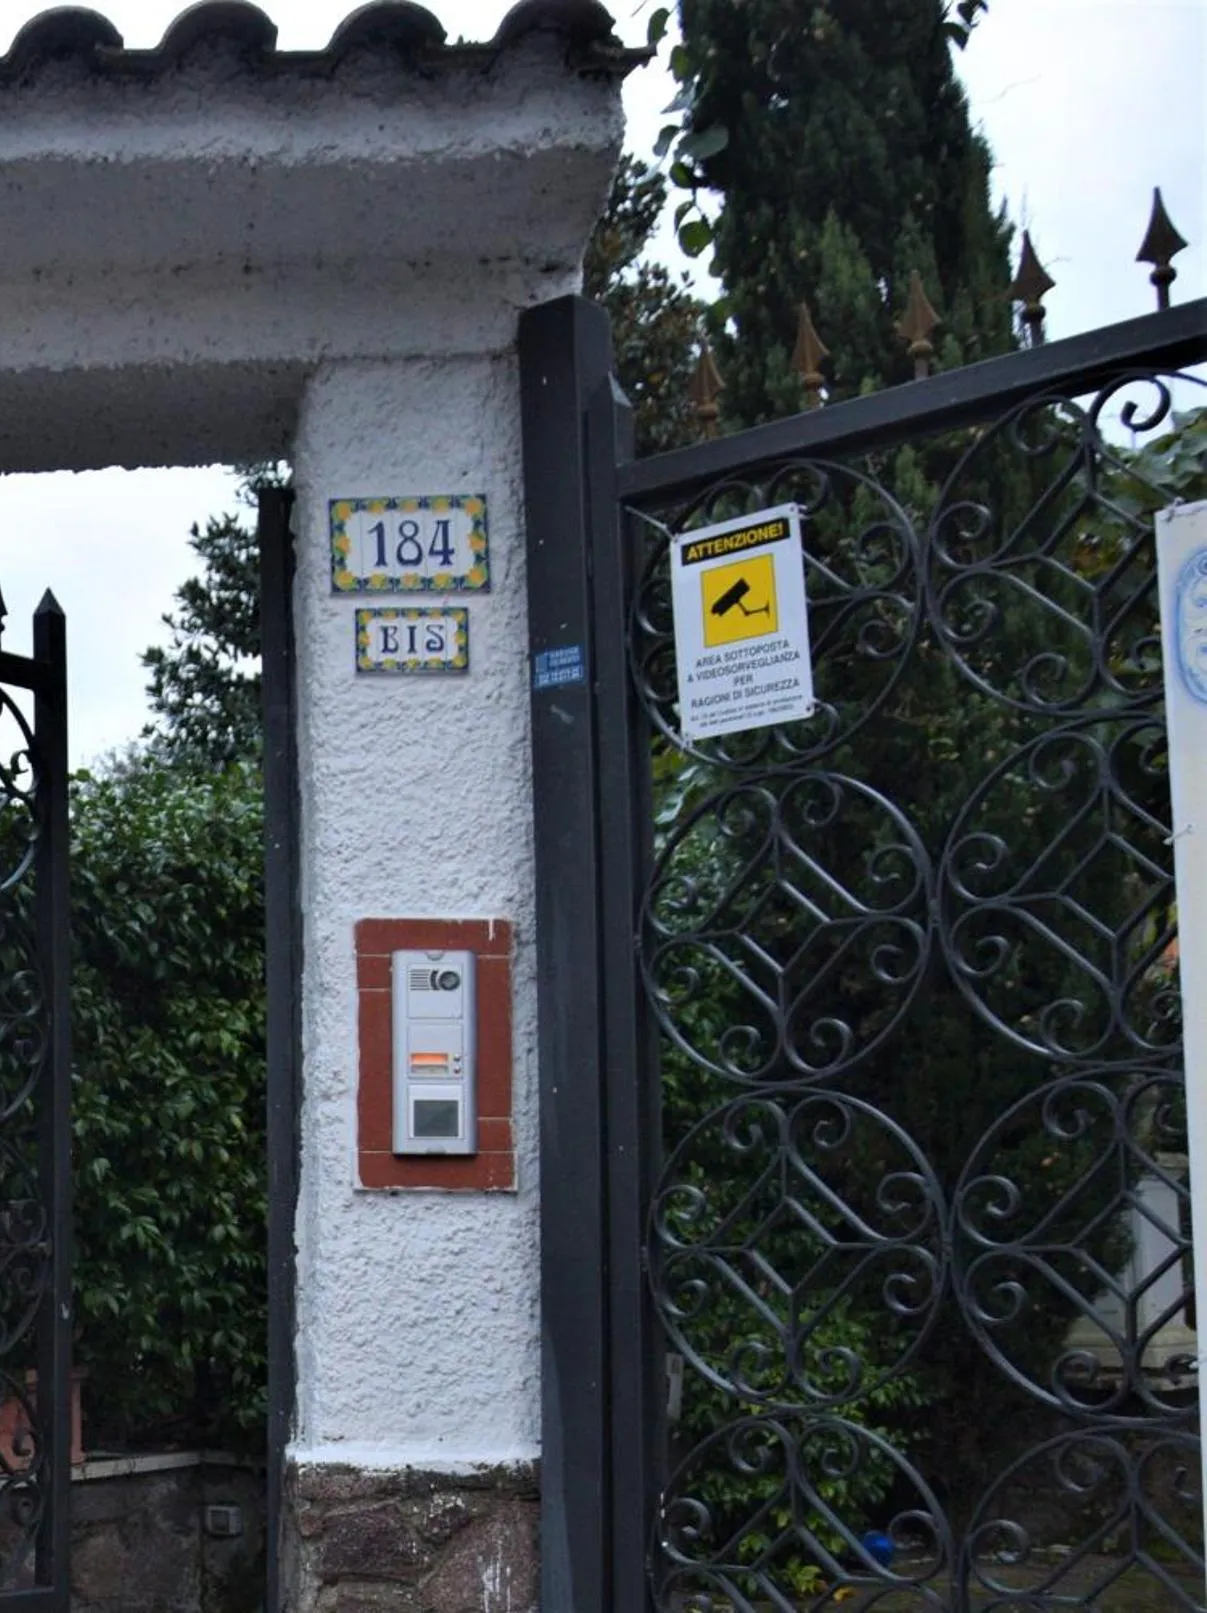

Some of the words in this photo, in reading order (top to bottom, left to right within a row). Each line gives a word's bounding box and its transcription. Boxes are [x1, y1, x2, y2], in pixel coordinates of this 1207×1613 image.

[368, 520, 455, 567] 184
[686, 521, 784, 561] ATTENZIONE!
[381, 624, 445, 653] BIS
[696, 654, 722, 668] AREA
[724, 639, 789, 661] SOTTOPOSTA
[687, 673, 694, 683] A
[733, 674, 753, 686] PER
[691, 692, 730, 708] RAGIONI
[733, 690, 742, 700] DI
[744, 678, 800, 697] SICUREZZA
